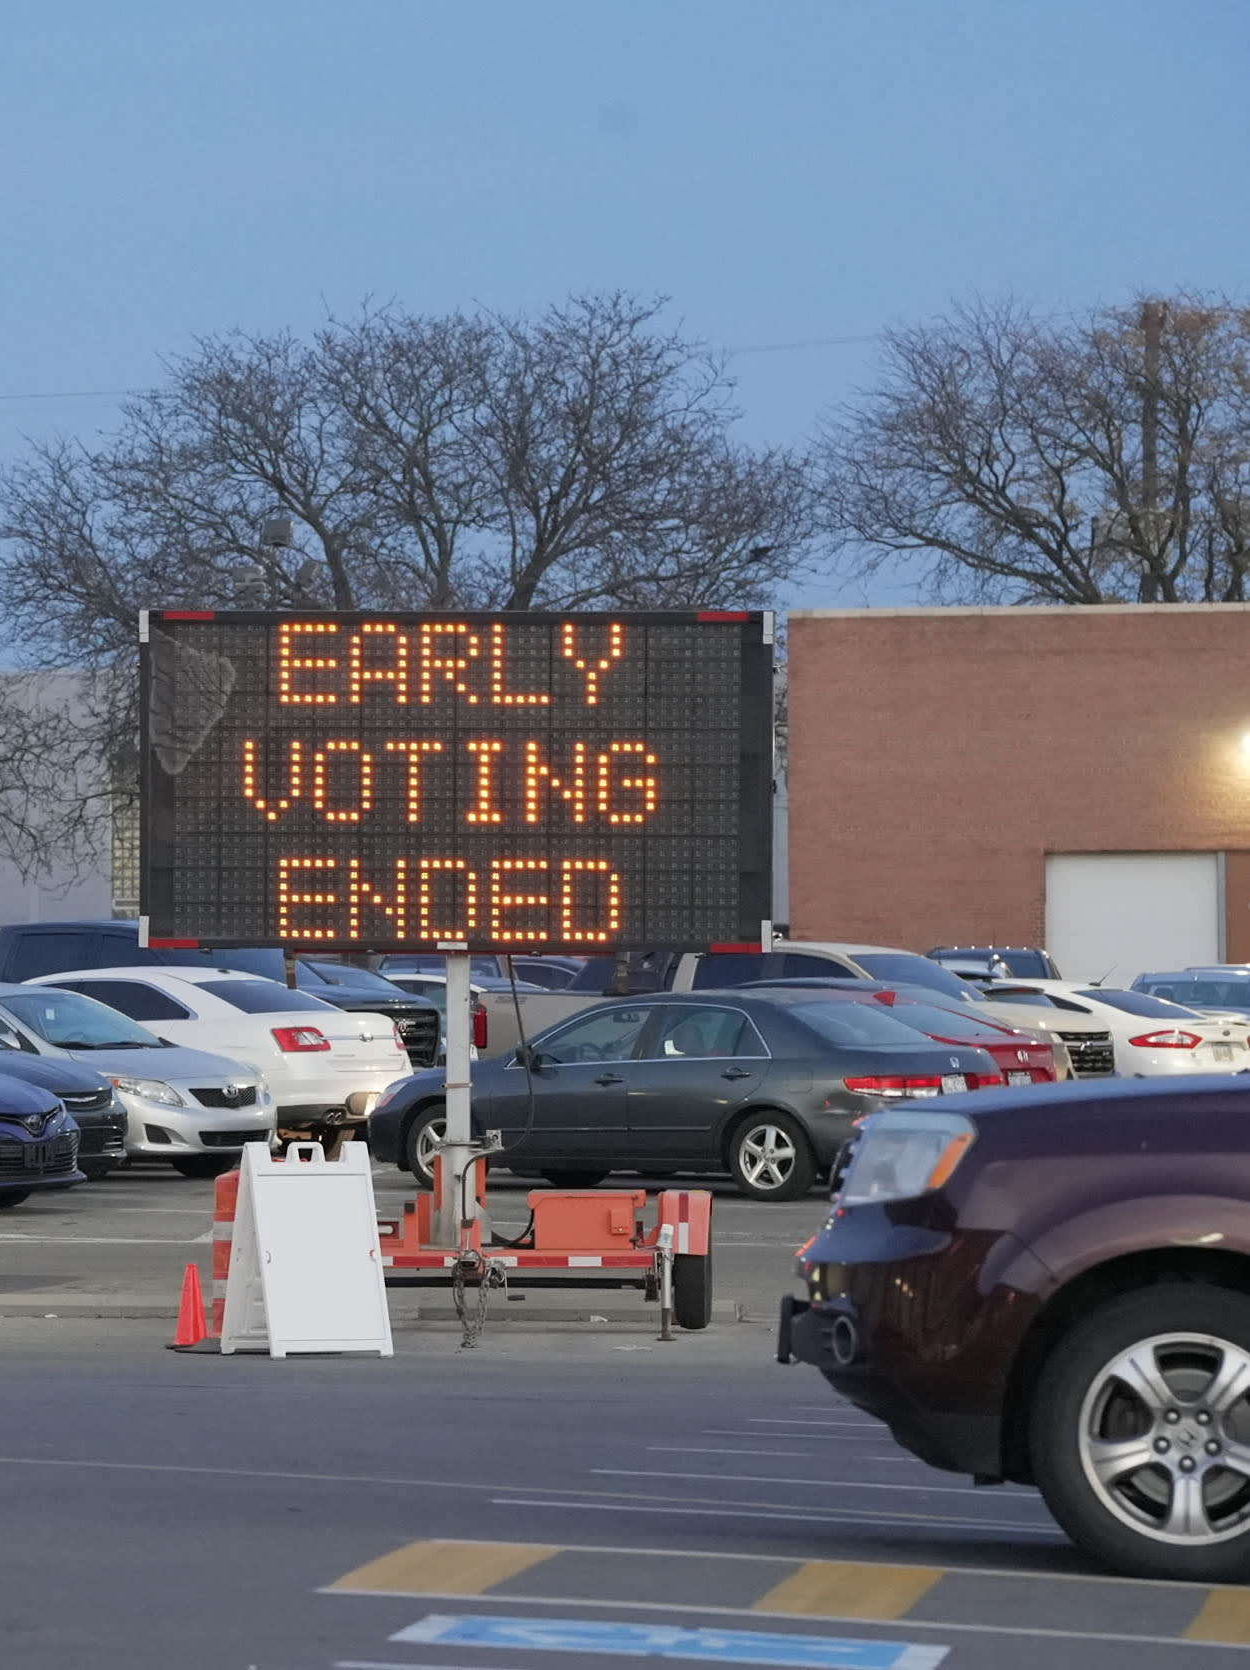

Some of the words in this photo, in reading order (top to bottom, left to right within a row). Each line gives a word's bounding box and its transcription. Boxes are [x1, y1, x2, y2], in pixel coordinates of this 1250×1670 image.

[280, 623, 622, 705] EARLY
[243, 740, 657, 823] VOTING
[279, 858, 620, 942] ENDED
